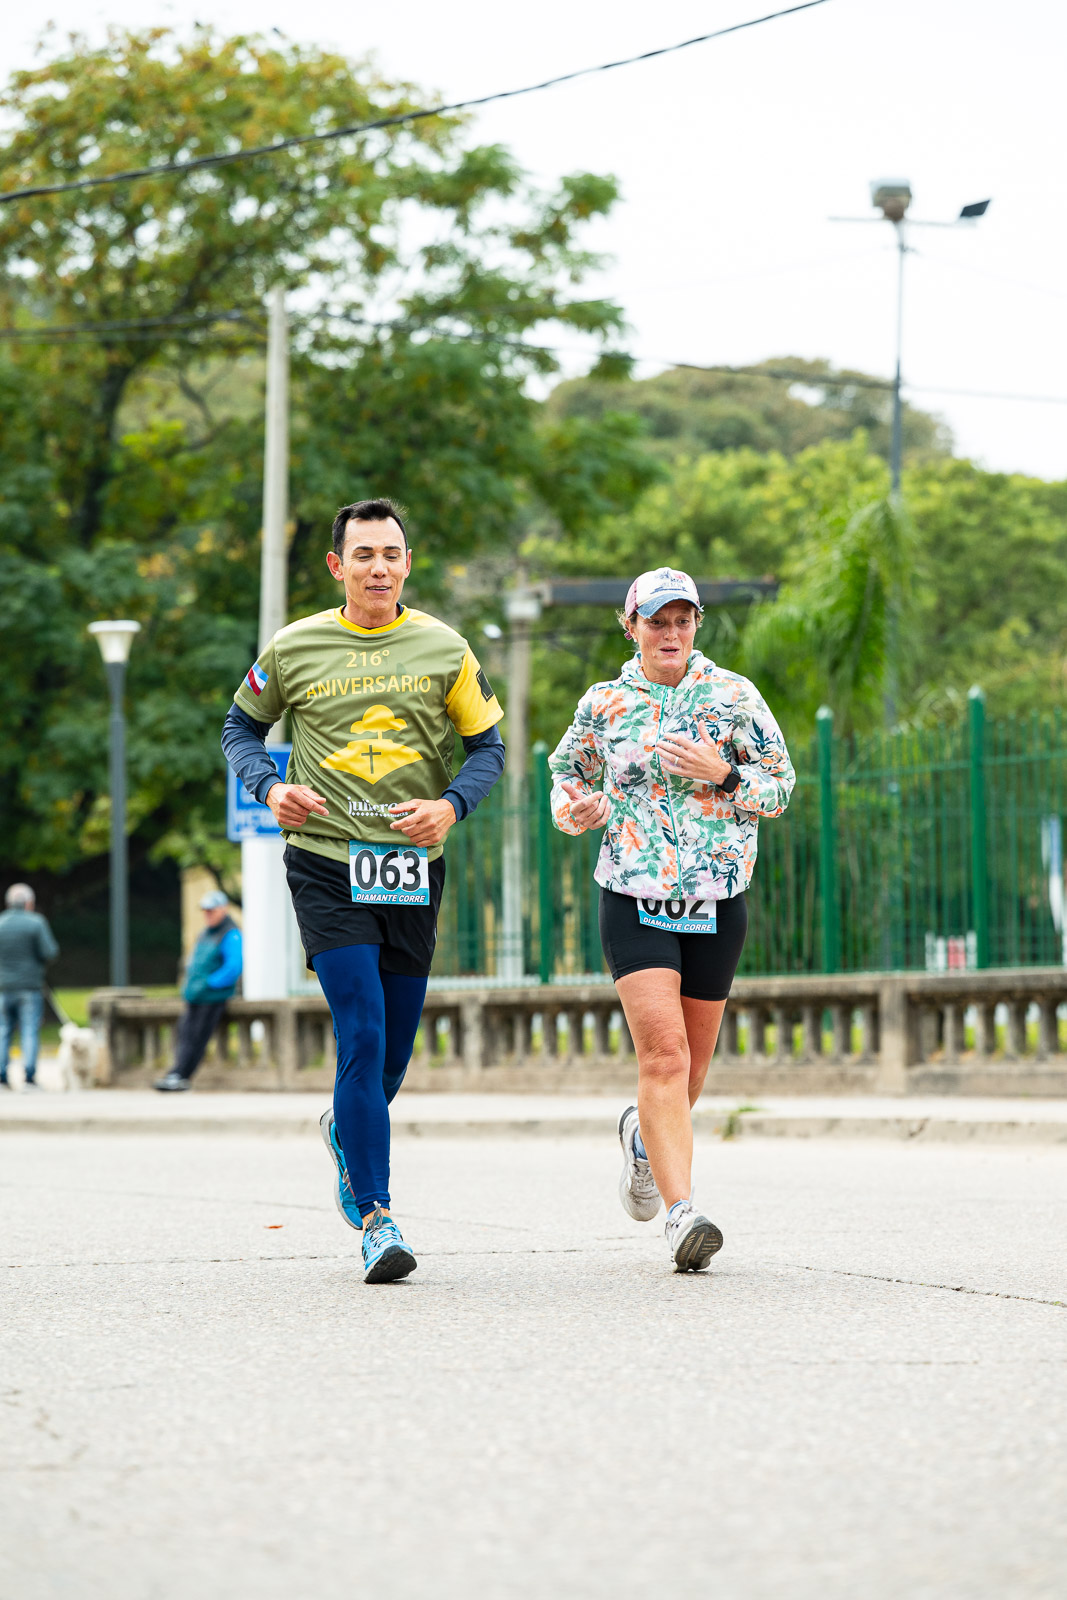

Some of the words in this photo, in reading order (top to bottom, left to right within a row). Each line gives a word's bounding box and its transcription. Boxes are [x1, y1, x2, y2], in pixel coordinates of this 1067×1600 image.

[345, 649, 390, 668] 216°
[306, 675, 432, 700] ANIVERSARIO
[355, 849, 421, 892] 063
[355, 893, 398, 902] DIAMANTE
[399, 894, 426, 903] CORRE
[643, 917, 682, 930] DIAMANTE
[683, 923, 712, 931] CORRE
